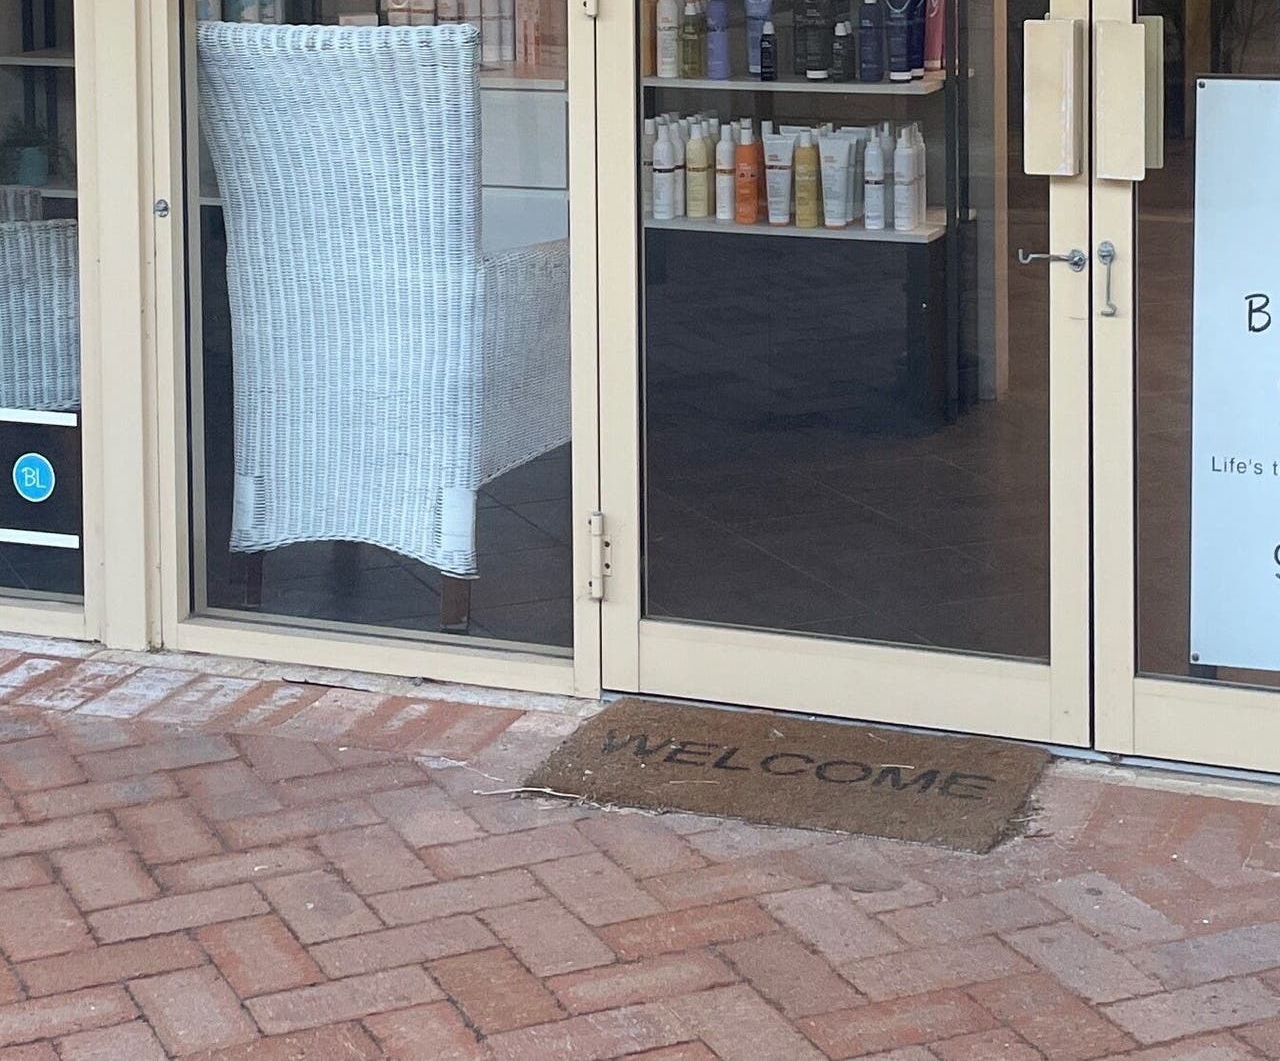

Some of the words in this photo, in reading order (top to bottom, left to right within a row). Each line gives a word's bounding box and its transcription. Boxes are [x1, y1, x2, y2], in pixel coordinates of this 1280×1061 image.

[1210, 455, 1263, 476] Life's
[21, 466, 47, 489] BL
[600, 728, 997, 800] WELCOME
